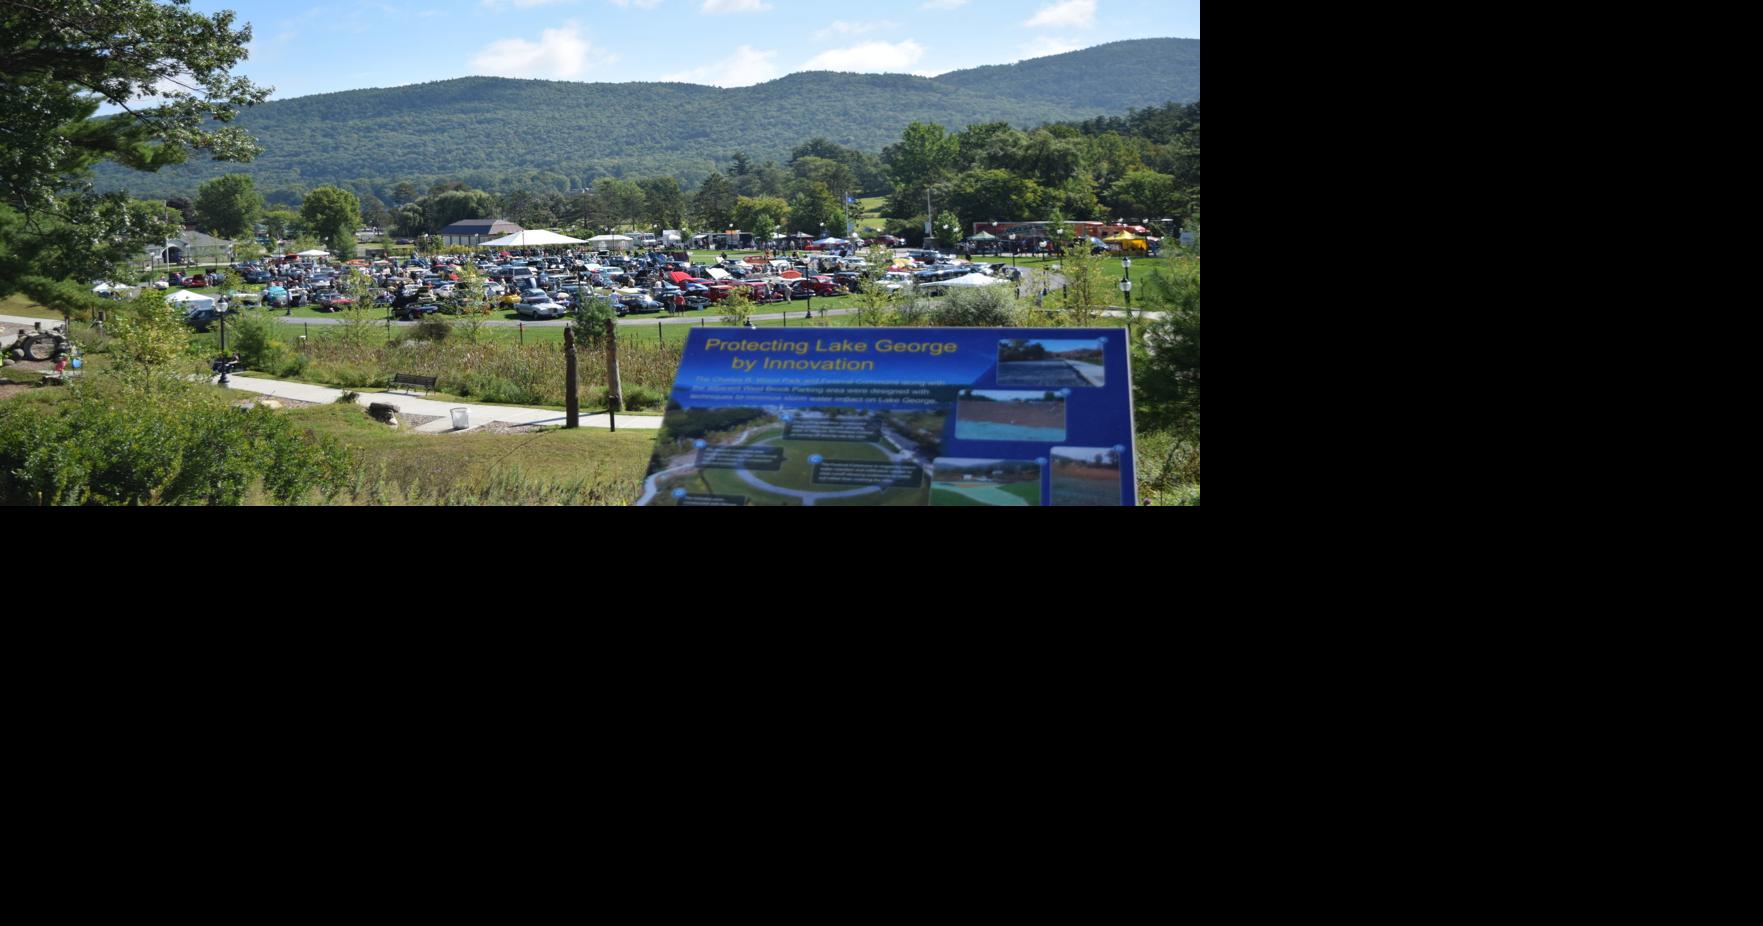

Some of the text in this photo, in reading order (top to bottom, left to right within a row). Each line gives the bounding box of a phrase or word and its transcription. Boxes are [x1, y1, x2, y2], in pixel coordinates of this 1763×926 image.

[705, 338, 957, 355] Protecting Lake George
[732, 357, 875, 372] by Innovation
[792, 386, 823, 395] Parking
[870, 387, 910, 396] designed
[902, 397, 938, 405] George.
